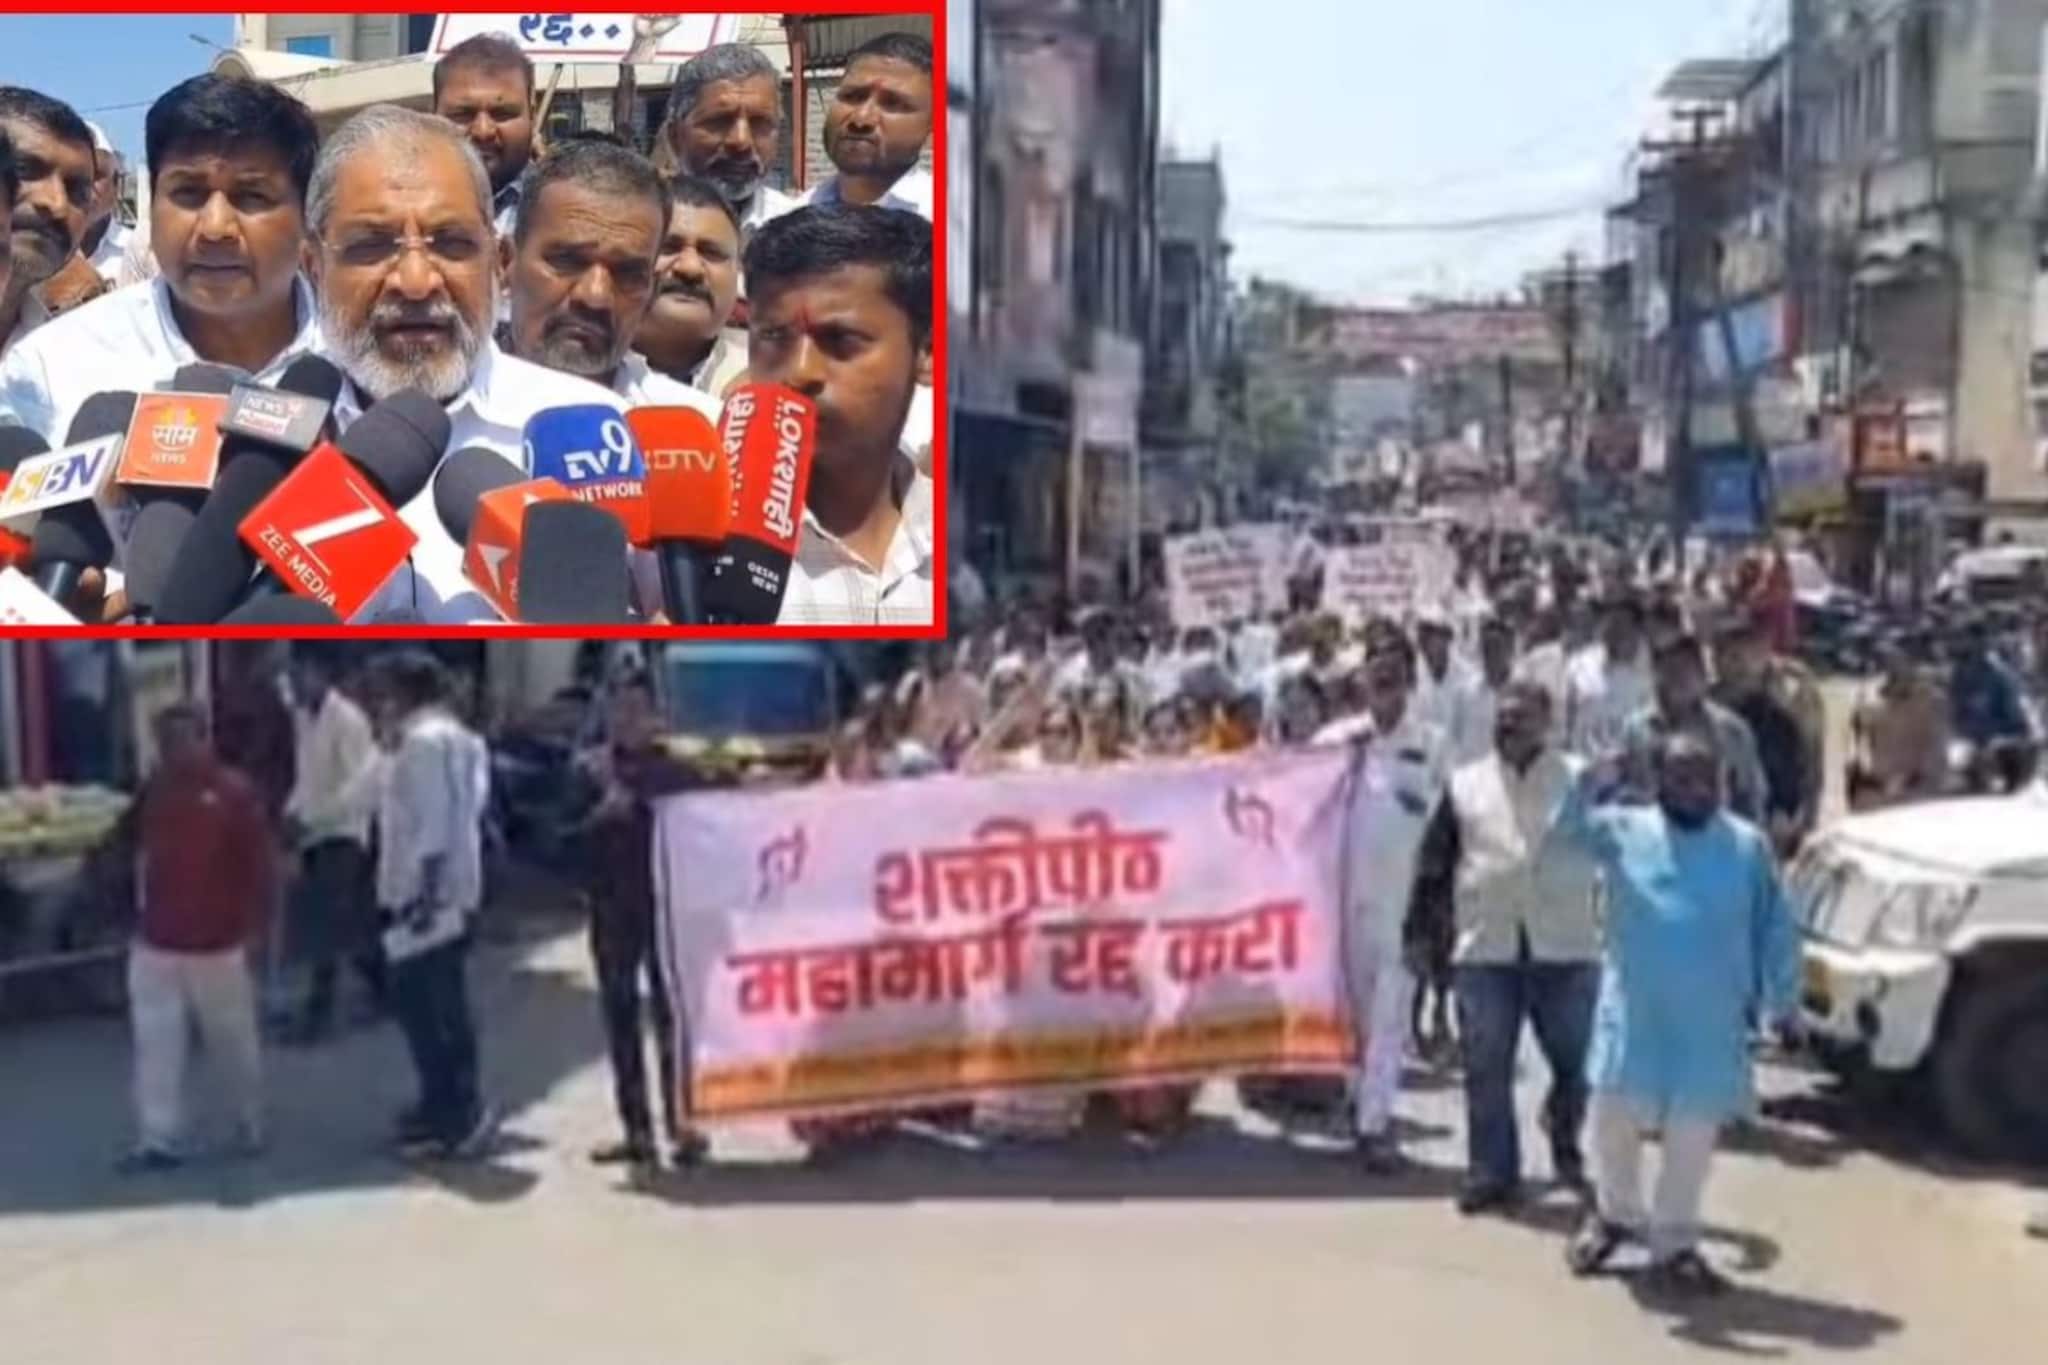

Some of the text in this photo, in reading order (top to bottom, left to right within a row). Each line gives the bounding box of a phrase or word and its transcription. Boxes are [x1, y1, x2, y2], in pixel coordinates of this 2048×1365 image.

[258, 522, 338, 607] ZEE MEDIA
[875, 810, 1170, 922] शक्तीपीठ
[727, 902, 1304, 1014] महामार्ग रद्द करा
